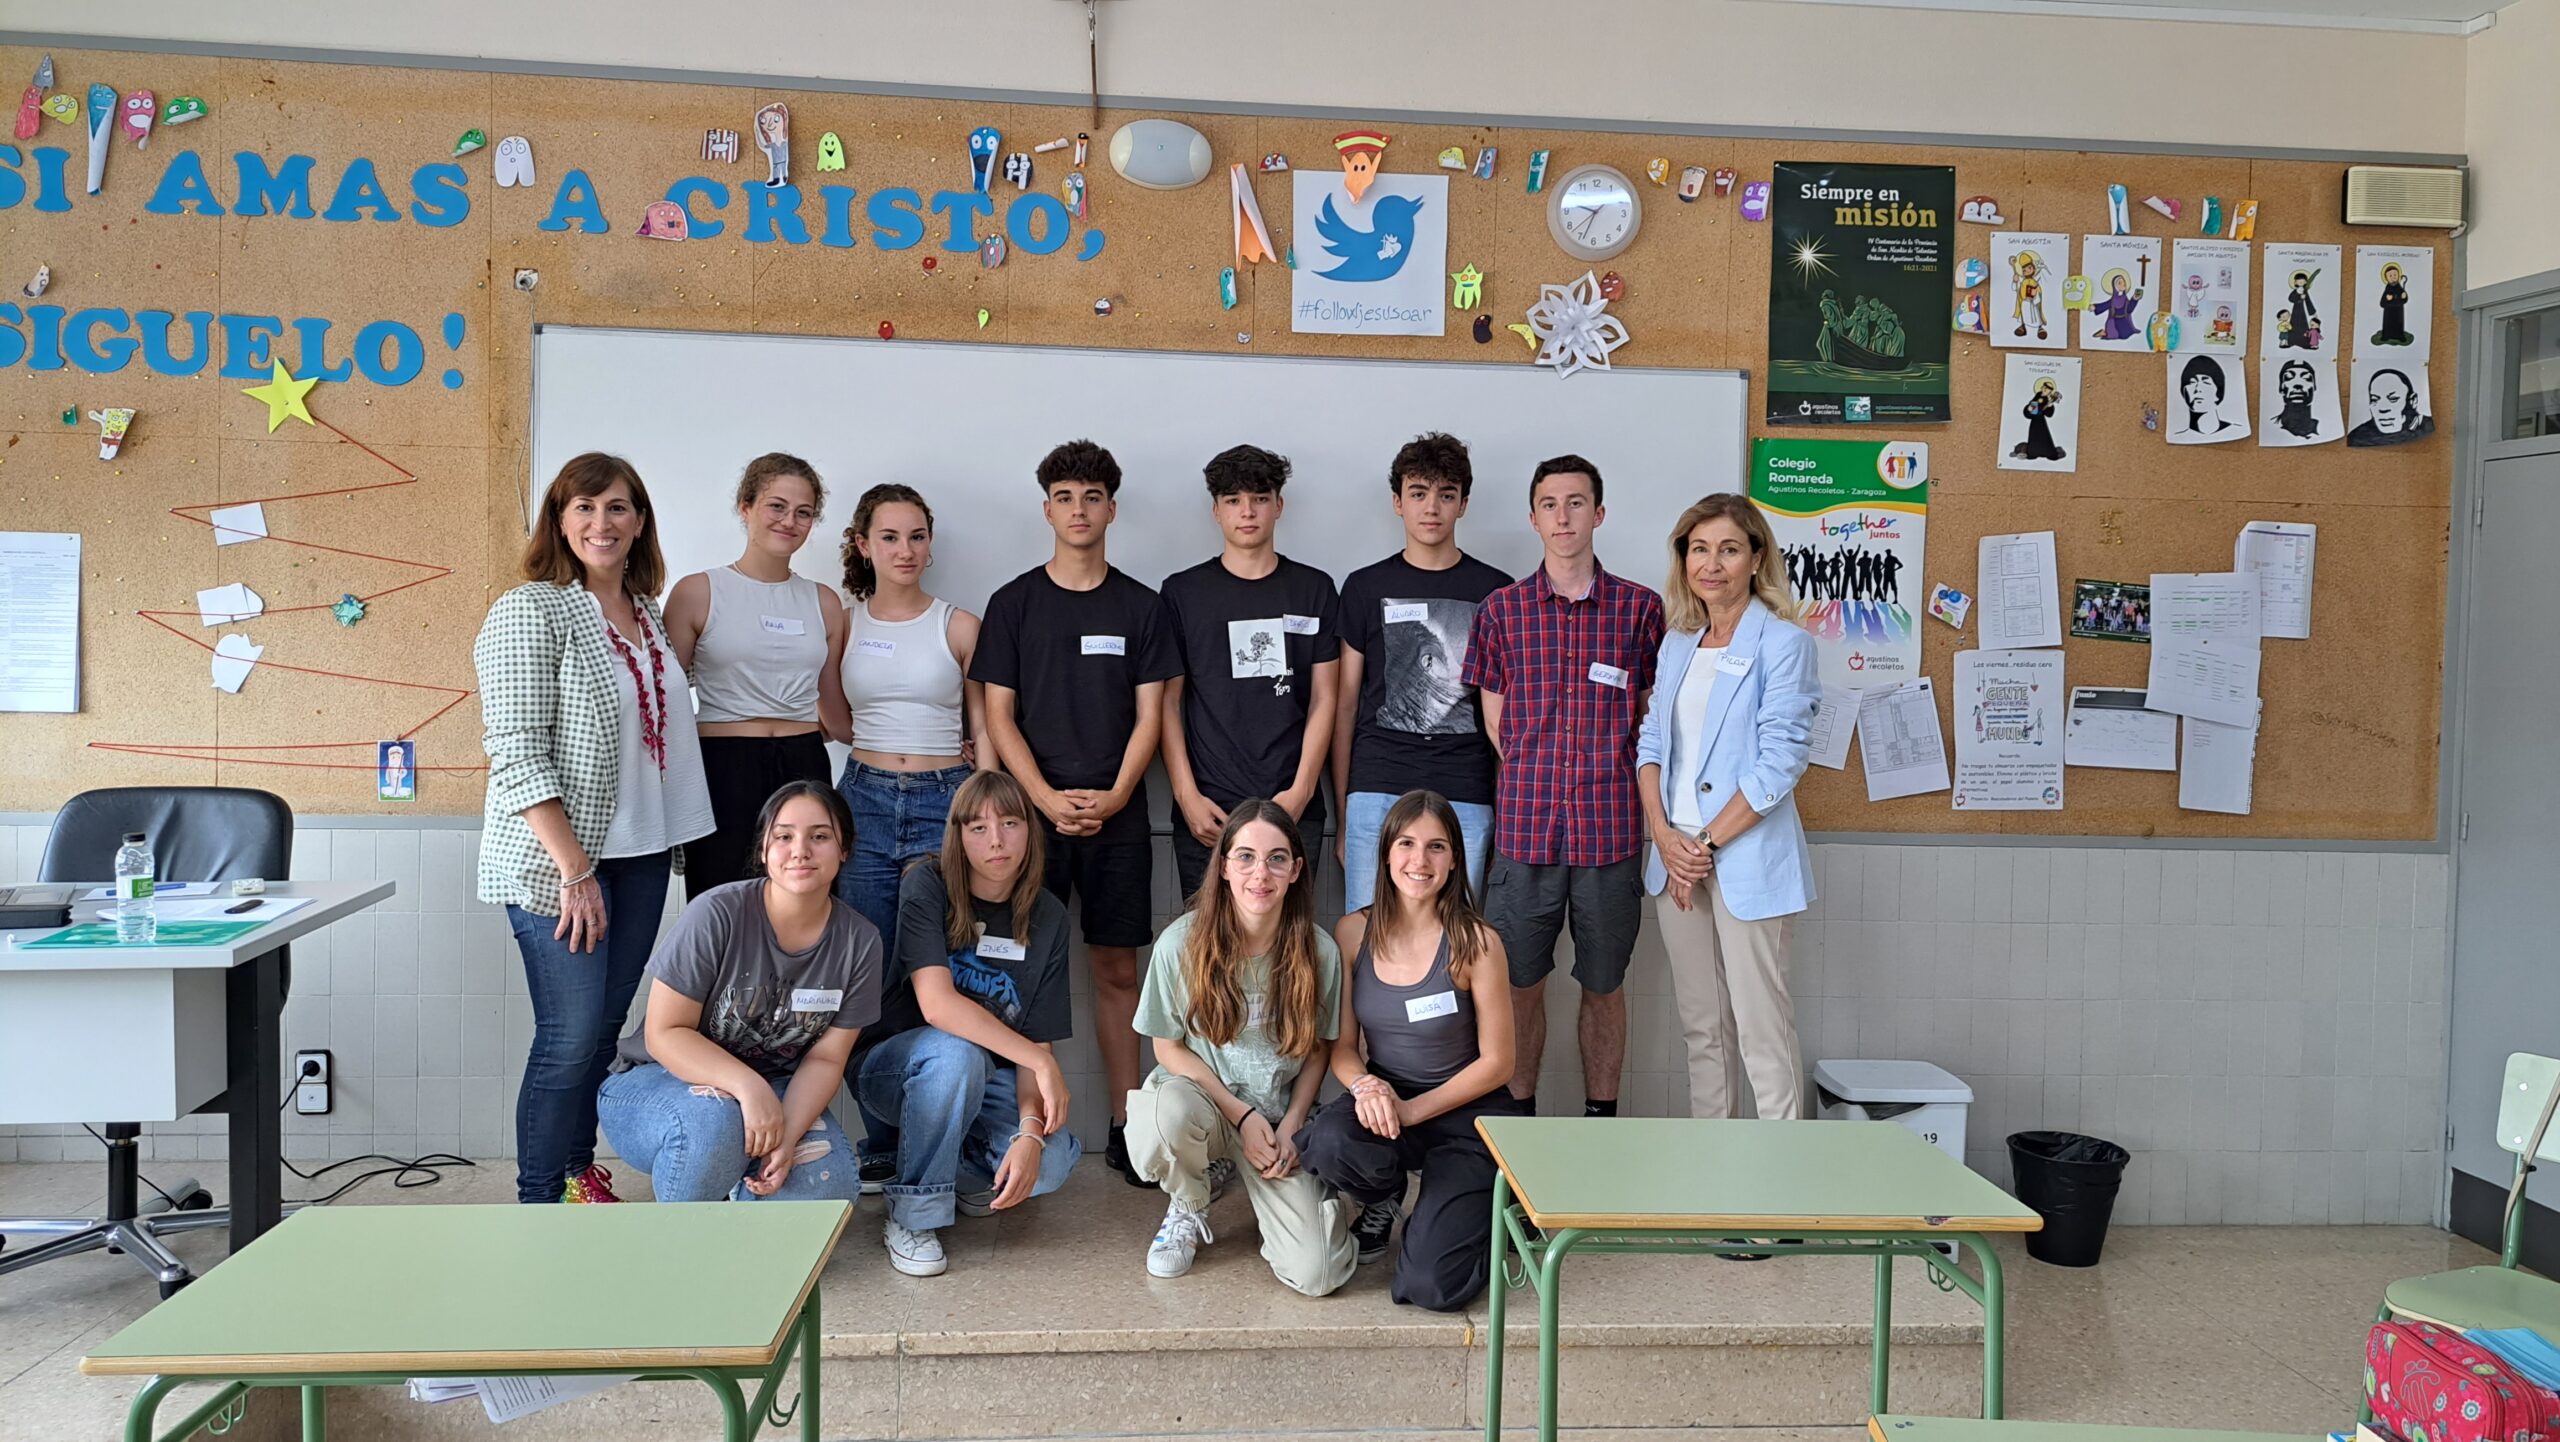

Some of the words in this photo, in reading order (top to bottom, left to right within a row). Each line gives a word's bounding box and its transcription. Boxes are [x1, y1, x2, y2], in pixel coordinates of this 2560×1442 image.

[1578, 183, 1587, 191] 11
[1592, 179, 1601, 188] 12
[1609, 184, 1613, 192] 1
[1800, 183, 1874, 204] Siempre
[1878, 186, 1901, 202] en
[145, 150, 470, 227] AMAS
[538, 169, 609, 233] A
[664, 176, 1105, 261] CRISTO,
[1621, 209, 1627, 218] 3
[1834, 202, 1937, 228] misión
[1566, 221, 1573, 230] 8
[1616, 224, 1622, 232] 4
[1577, 232, 1583, 240] 7
[1605, 233, 1612, 242] 5
[2007, 237, 2020, 245] SAN
[1590, 237, 1597, 246] 6
[2100, 241, 2121, 249] SANTA
[1298, 298, 1432, 329] #followjesusoar
[1768, 457, 1817, 471] Colegio
[1768, 472, 1834, 485] Romareda
[1768, 485, 1807, 495] Agustinos
[1807, 486, 1846, 495] Recoletos
[1851, 487, 1887, 497] Zaragoza
[1820, 513, 1897, 541] together
[1869, 529, 1901, 540] juntos
[1866, 655, 1900, 663] agustinos
[1869, 662, 1905, 671] recoletos
[1986, 686, 2029, 700] GENTE
[982, 943, 1009, 954] INÉS
[1414, 1000, 1442, 1014] LUISA
[1922, 1132, 1938, 1144] 19
